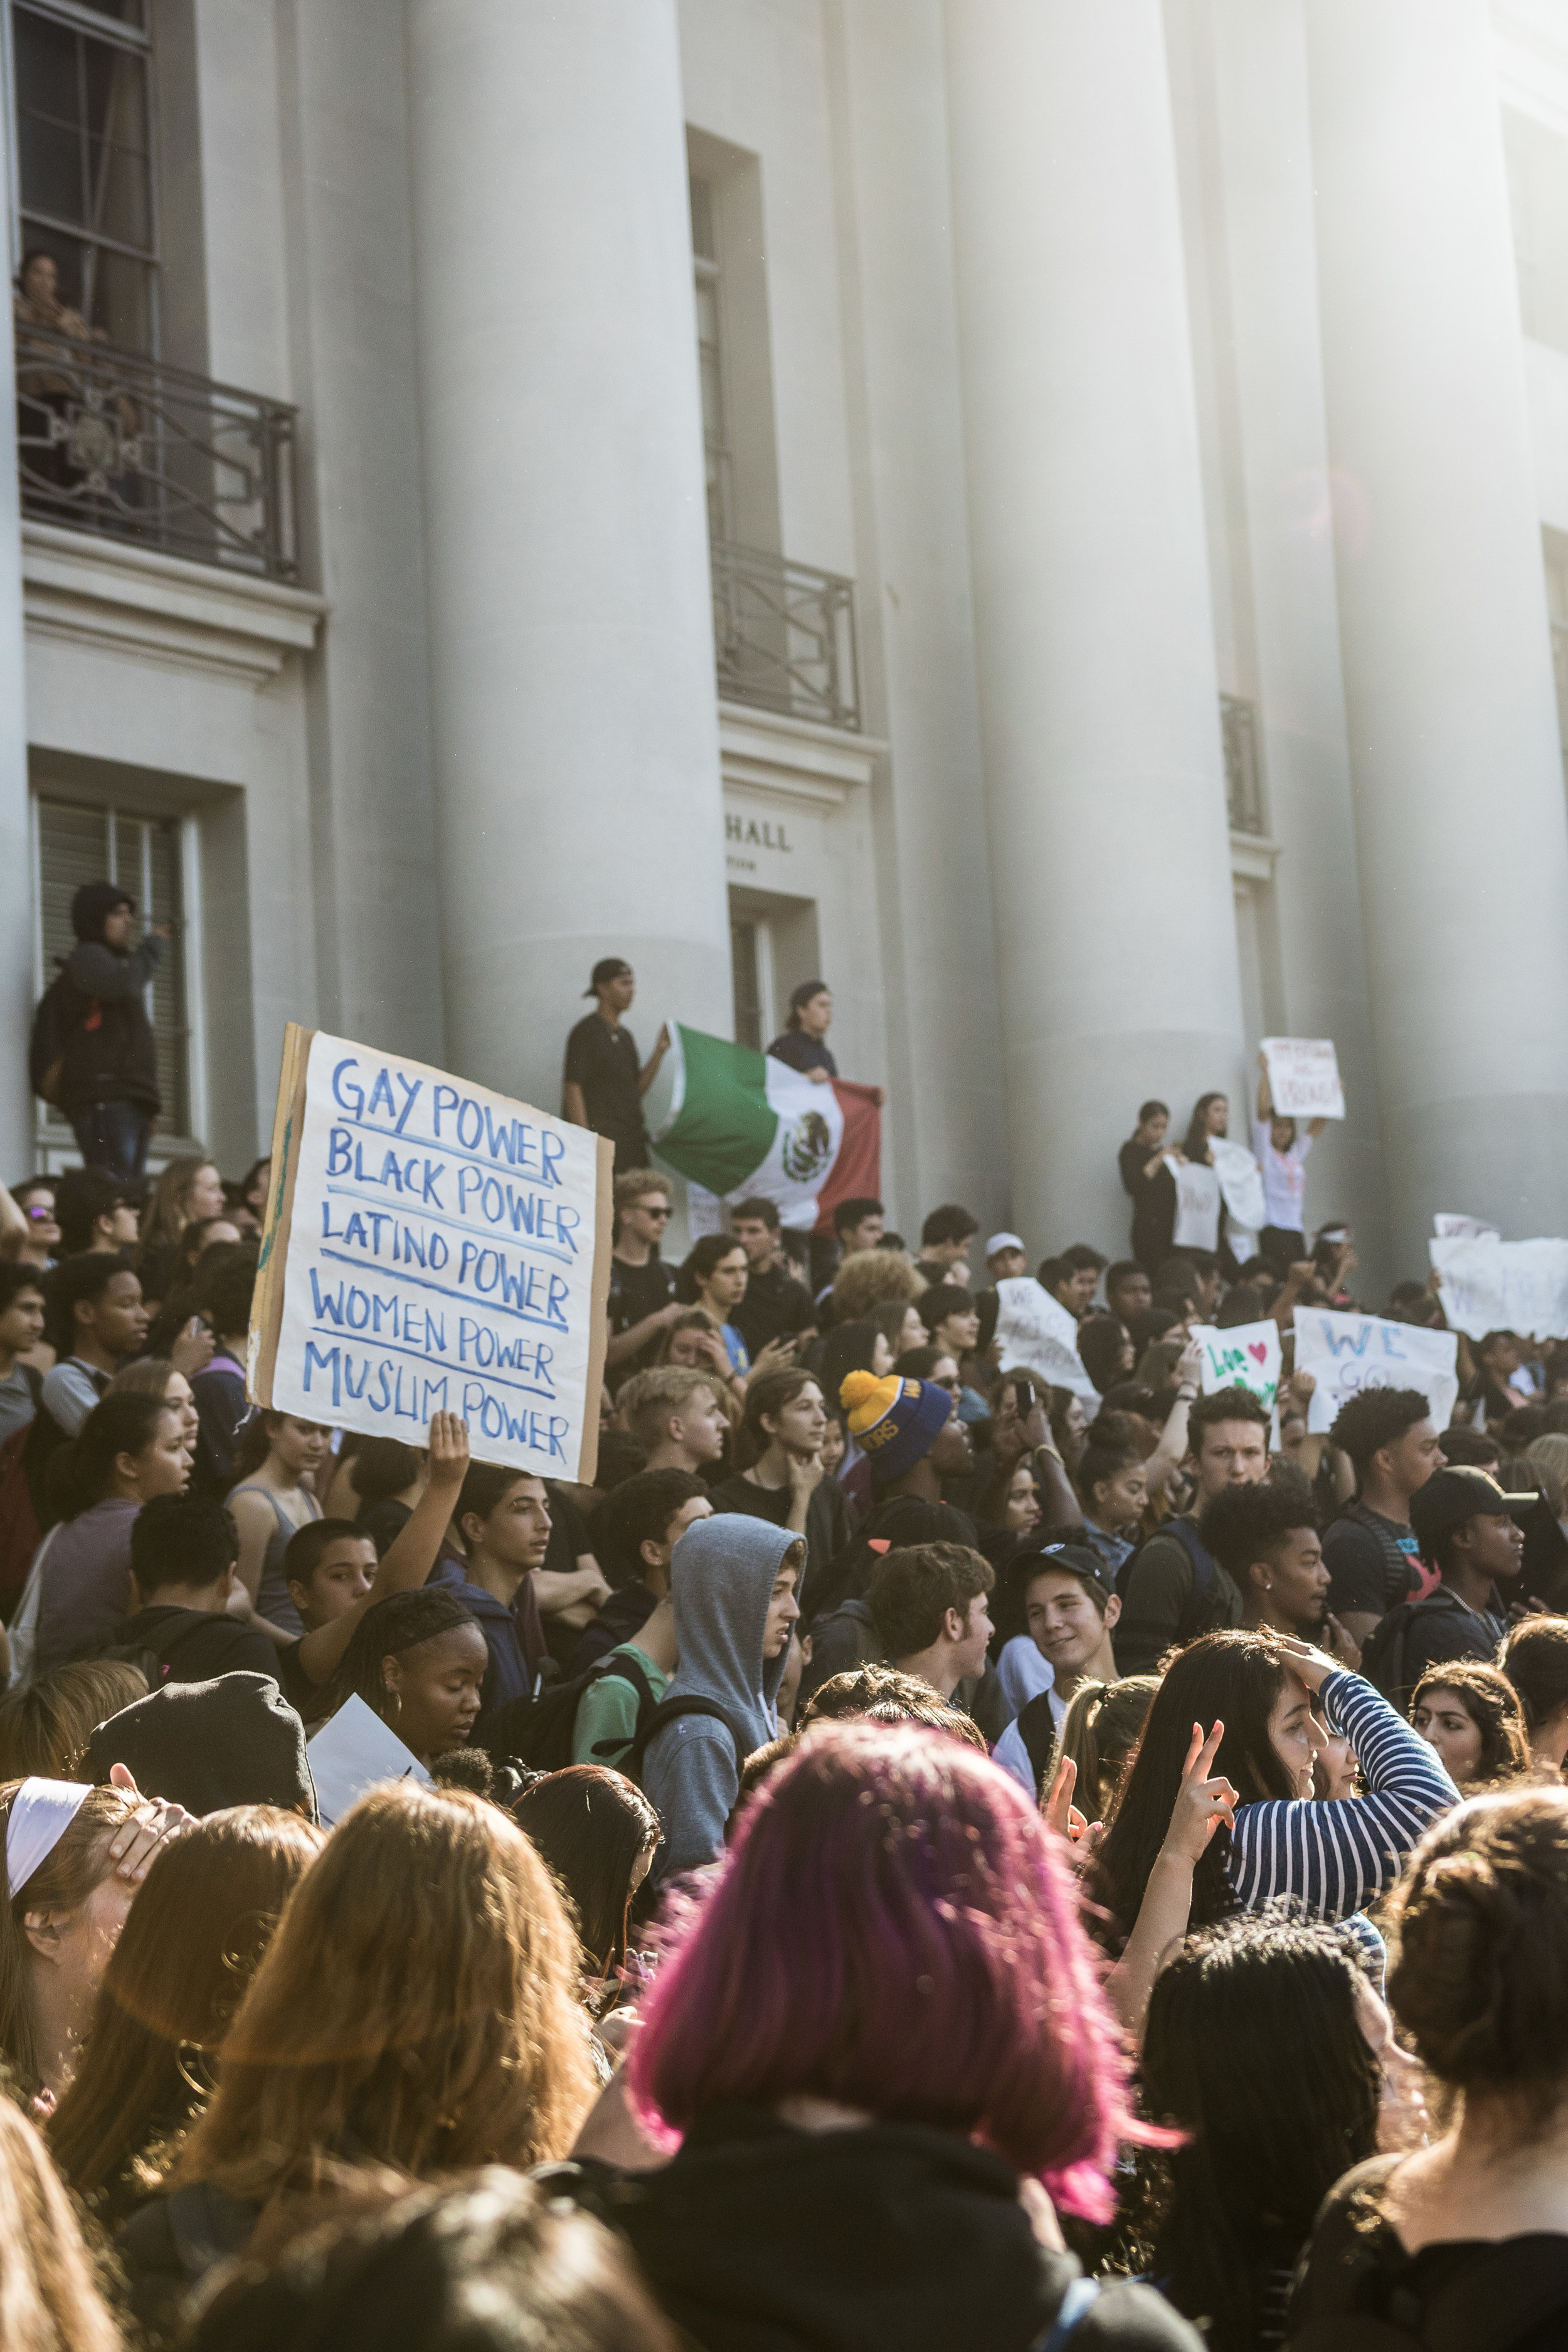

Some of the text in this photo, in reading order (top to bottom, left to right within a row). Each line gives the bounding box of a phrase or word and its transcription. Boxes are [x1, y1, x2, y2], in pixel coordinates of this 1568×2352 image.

[724, 813, 792, 852] HALL
[332, 1059, 565, 1185] GAY POWER
[326, 1128, 581, 1253] BLACK POWER
[322, 1201, 569, 1322] LATINO POWER
[309, 1268, 554, 1385] WOMEN POWER
[1319, 1318, 1407, 1359] WE
[302, 1342, 569, 1464] MUSLIM POWER
